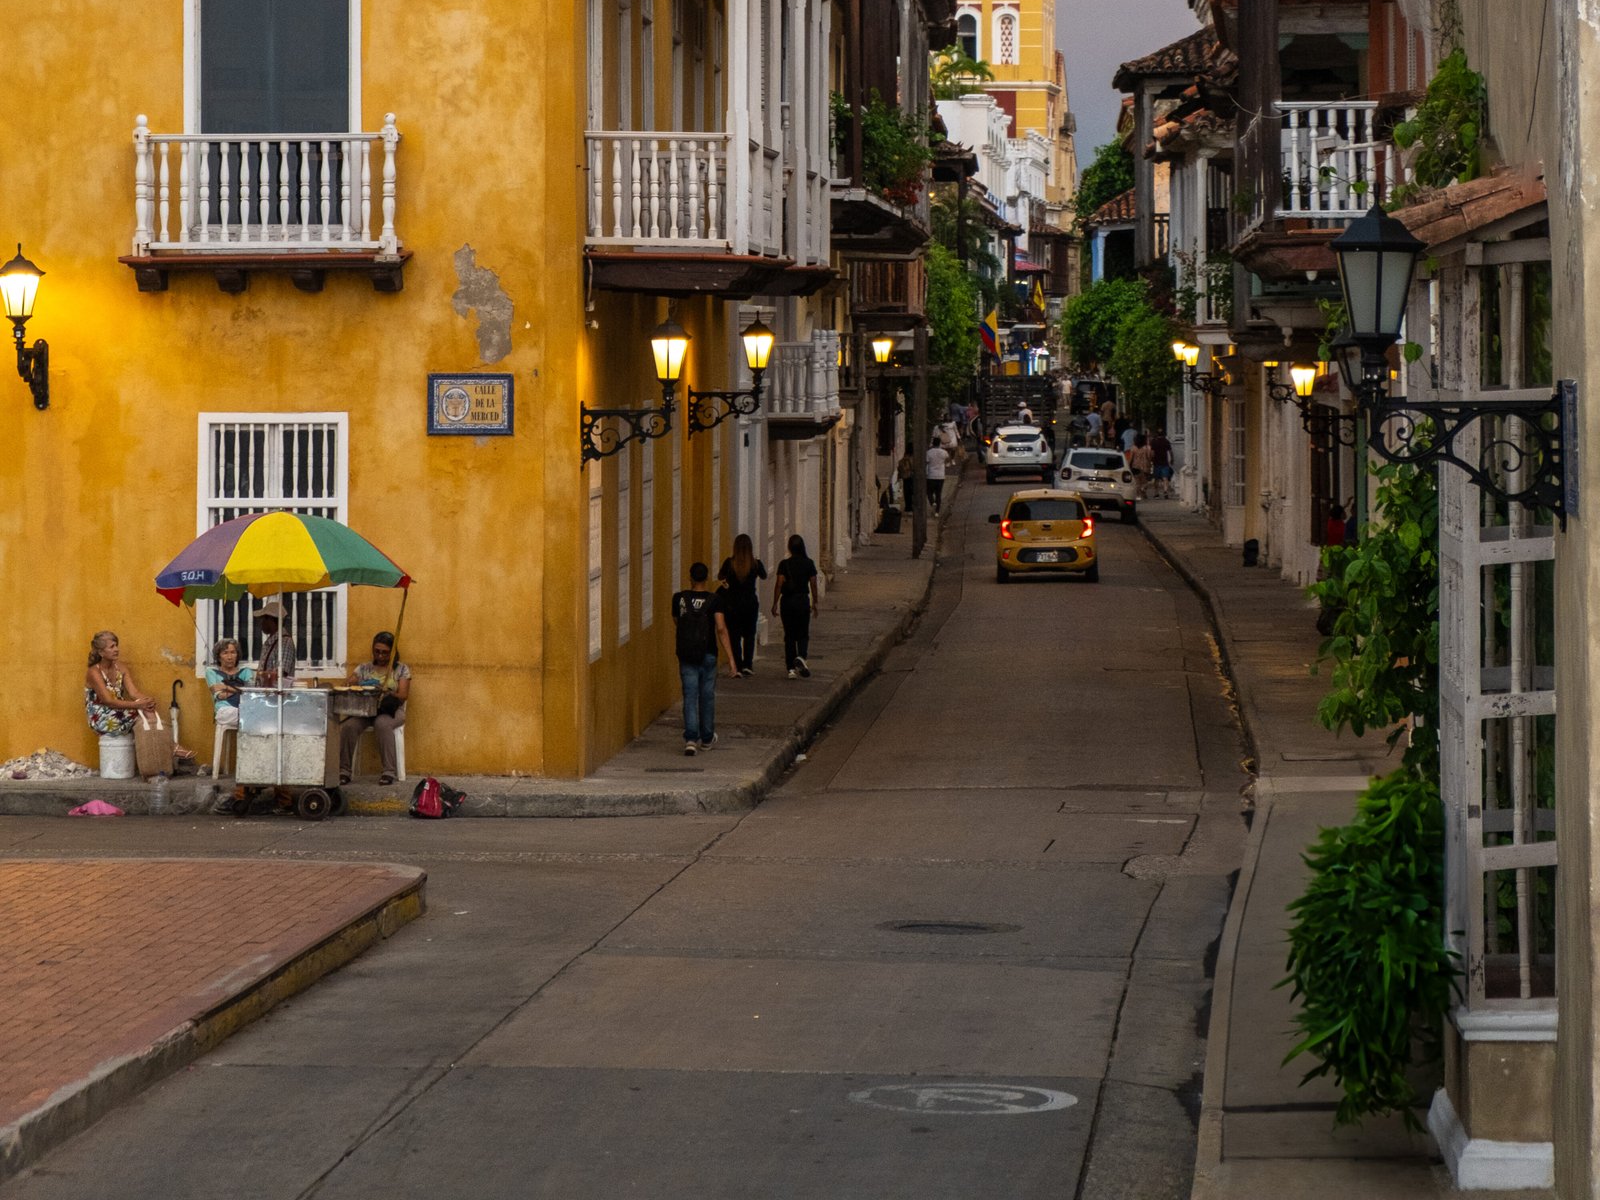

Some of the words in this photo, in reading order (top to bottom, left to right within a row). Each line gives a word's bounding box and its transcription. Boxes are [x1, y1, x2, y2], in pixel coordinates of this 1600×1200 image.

[474, 385, 496, 395] CALLE
[475, 398, 485, 408] DE
[486, 398, 495, 408] LA
[470, 412, 500, 421] MERCED
